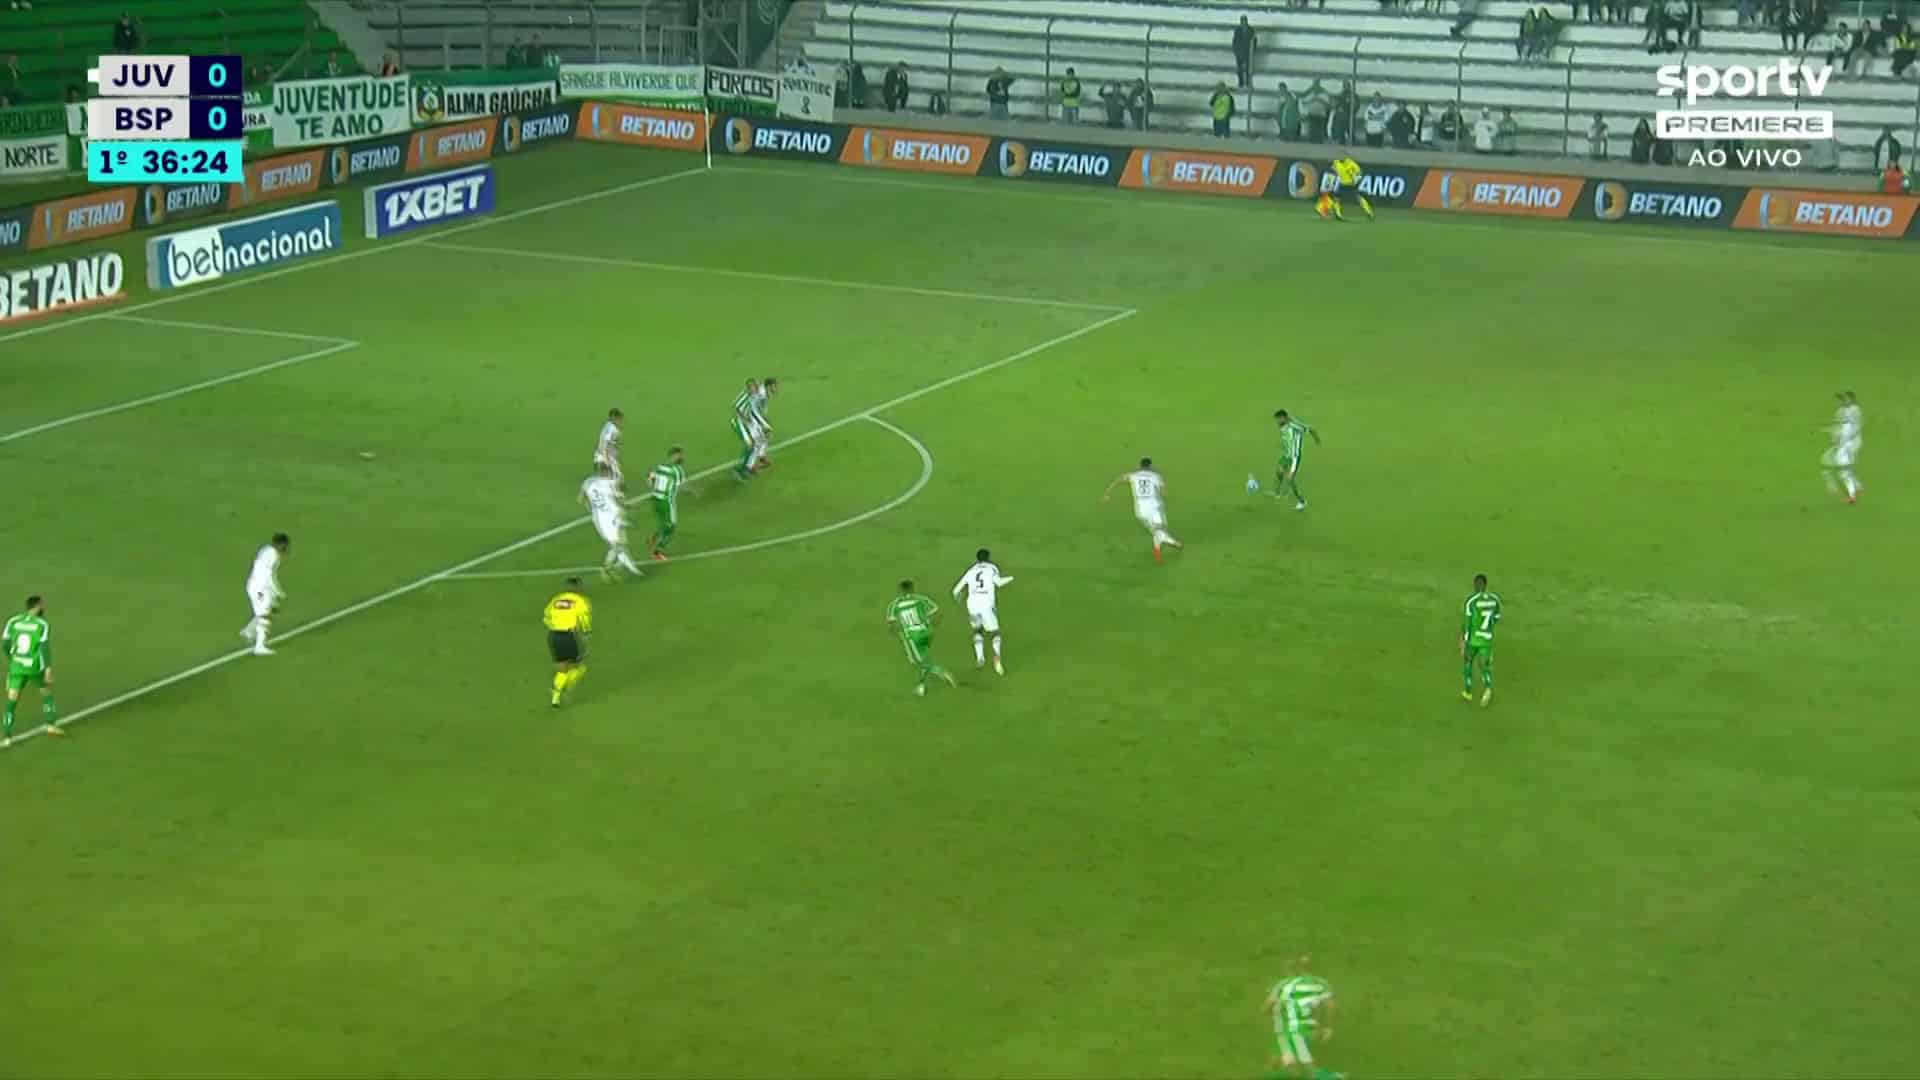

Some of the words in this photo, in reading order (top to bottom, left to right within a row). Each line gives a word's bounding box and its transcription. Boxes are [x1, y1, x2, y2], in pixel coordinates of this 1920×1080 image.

[274, 81, 405, 115] JUVENTUDE
[447, 91, 486, 115] ALMA
[296, 116, 322, 140] TE
[331, 113, 383, 137] AMO
[522, 114, 569, 139] BETANO
[621, 114, 696, 140] BETANO
[437, 129, 486, 156] BETANO
[754, 127, 832, 154] BETANO
[892, 139, 970, 165] BETANO
[4, 142, 60, 169] NORTE
[351, 146, 399, 174] BETANO
[1030, 151, 1110, 176] BETANO
[261, 161, 311, 191] BETANO
[1172, 161, 1255, 186] BETANO
[167, 183, 221, 211] BETANO
[385, 174, 486, 228] 1XBET
[1473, 183, 1562, 209] BETANO
[1629, 192, 1722, 218] BETANO
[67, 200, 125, 231] BETANO
[1795, 202, 1893, 228] BETANO
[171, 216, 333, 282] betnacional
[975, 570, 985, 589] 5
[1481, 611, 1494, 630] 7
